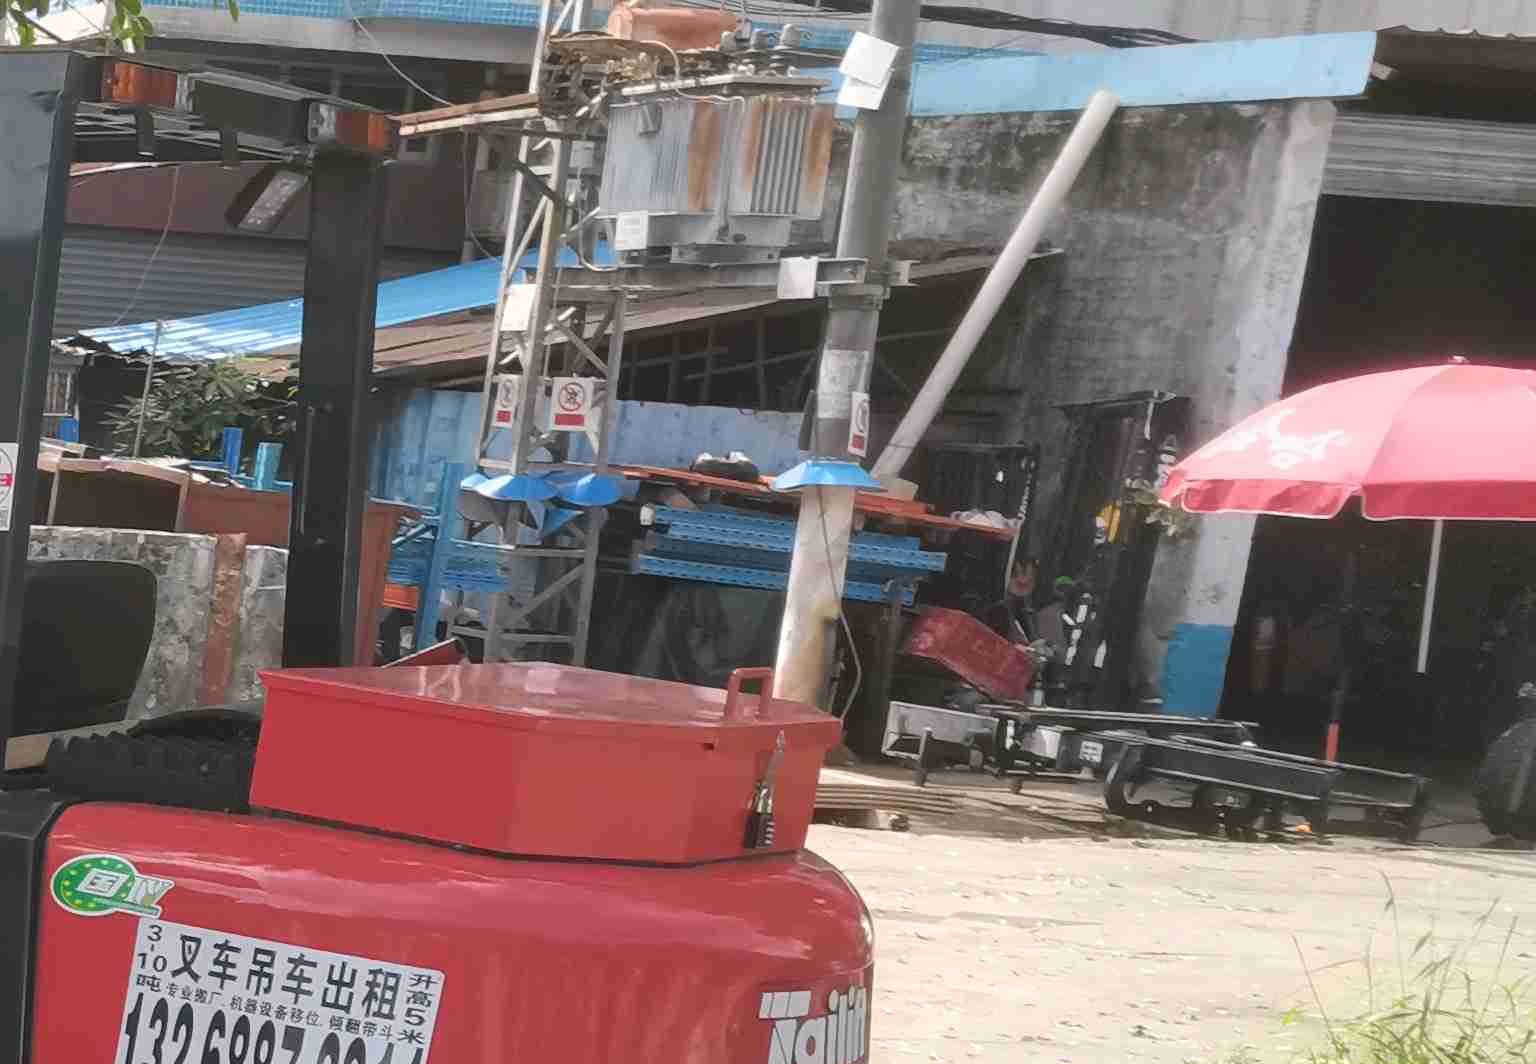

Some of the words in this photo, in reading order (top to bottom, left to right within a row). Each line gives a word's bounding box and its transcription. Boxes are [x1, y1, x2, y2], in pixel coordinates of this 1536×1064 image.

[171, 934, 402, 1021] 叉车吊车出租
